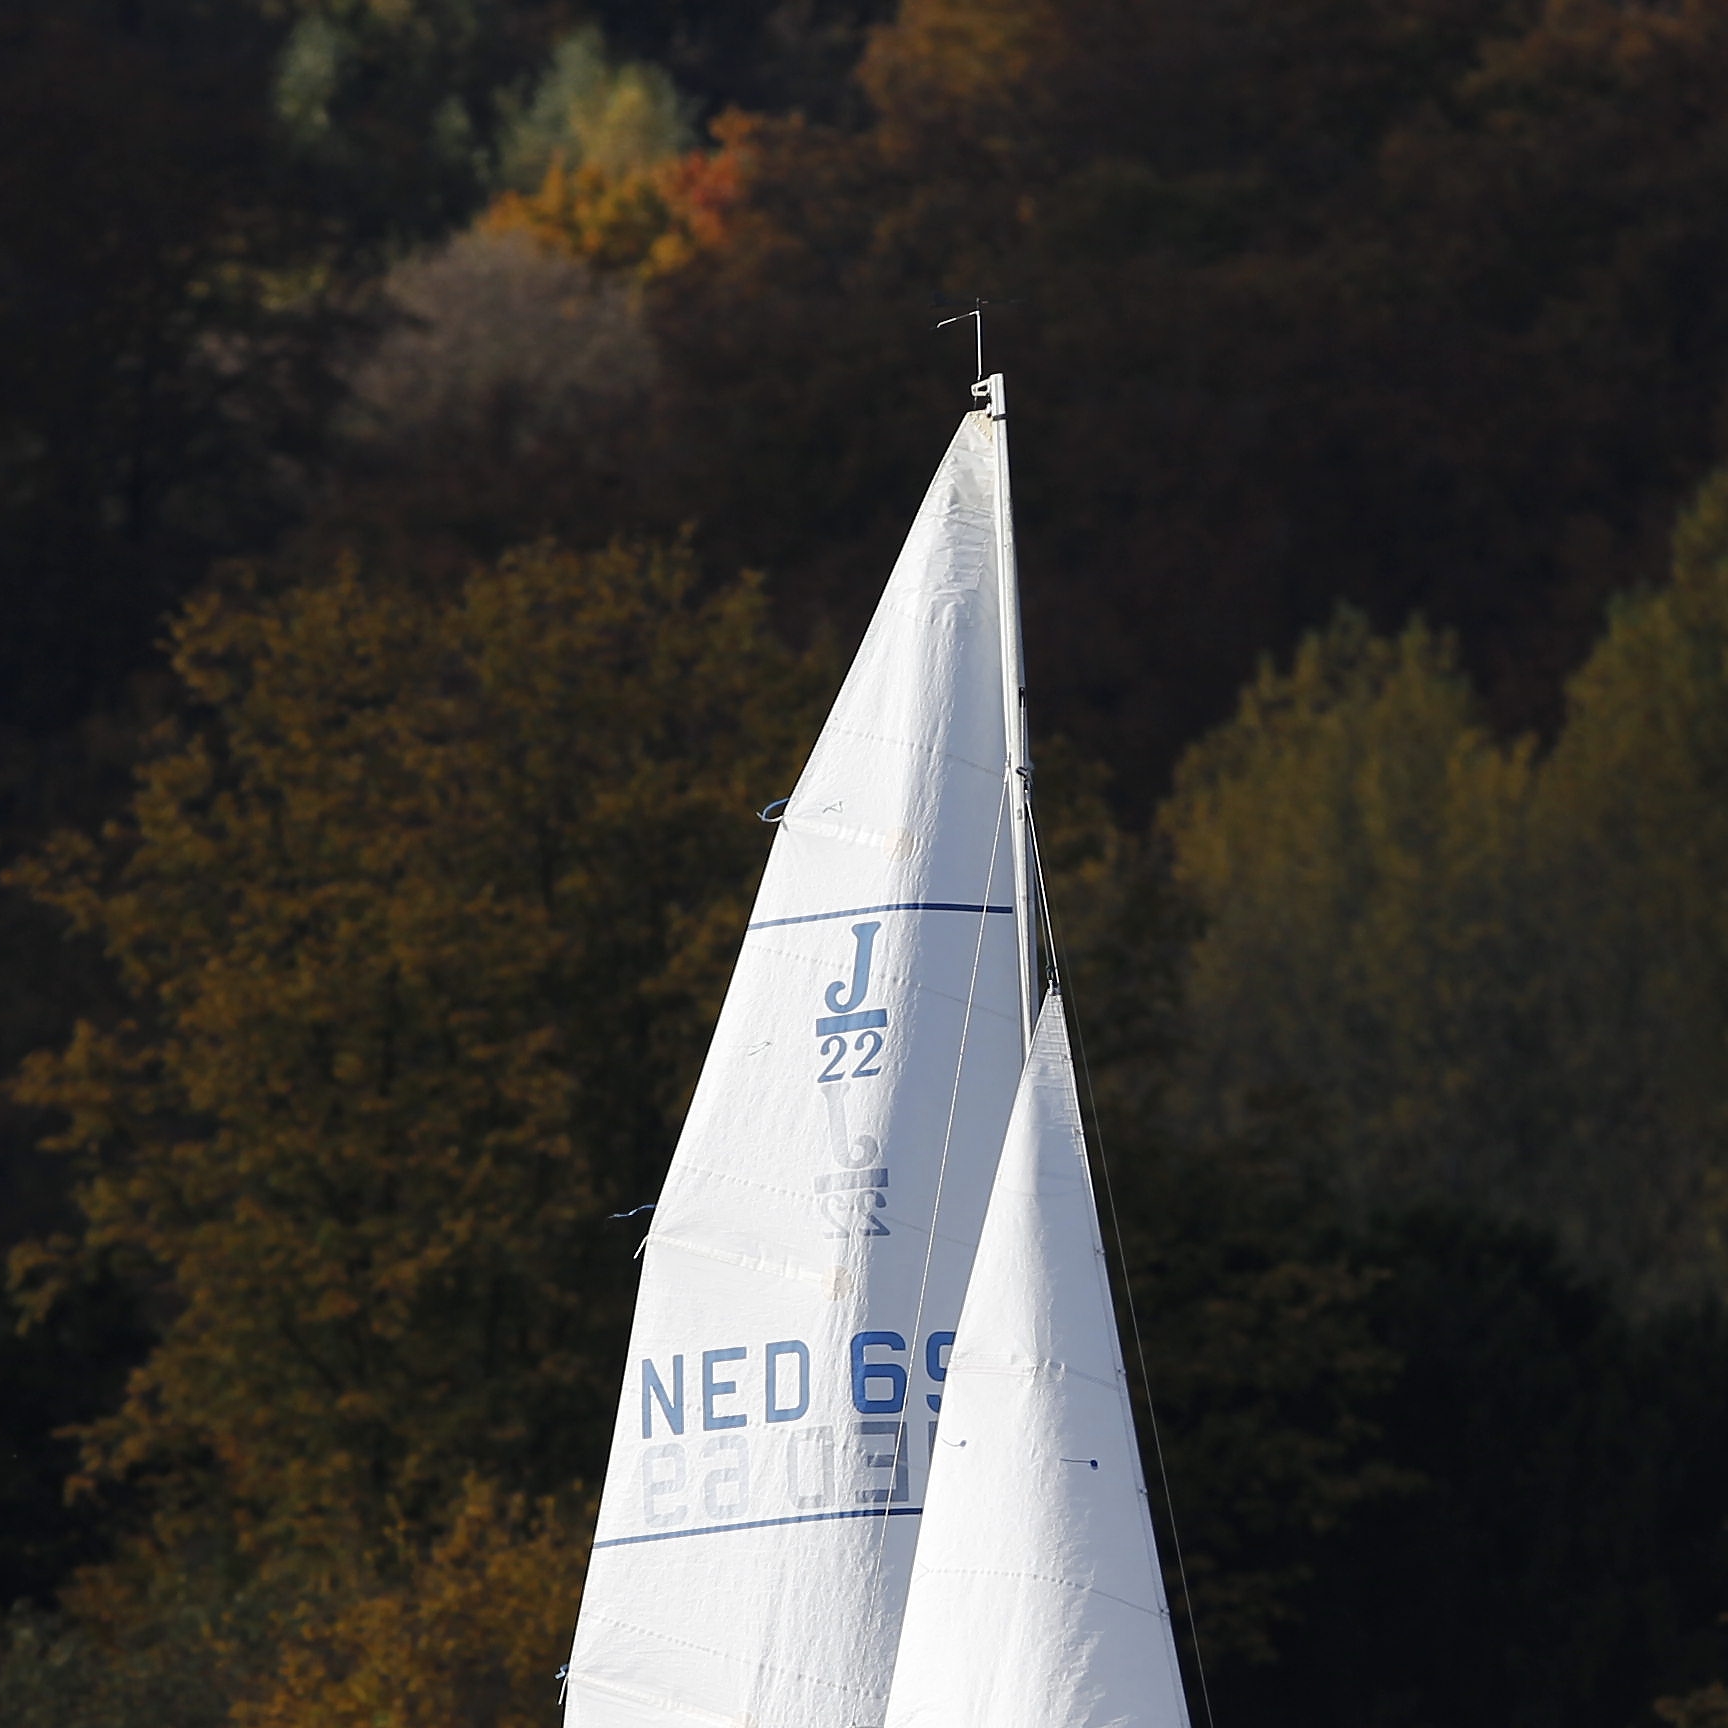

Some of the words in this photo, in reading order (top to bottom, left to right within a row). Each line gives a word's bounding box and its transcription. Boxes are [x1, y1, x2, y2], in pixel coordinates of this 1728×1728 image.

[824, 921, 880, 1013] J
[817, 1032, 883, 1083] 22
[642, 1340, 810, 1438] NED
